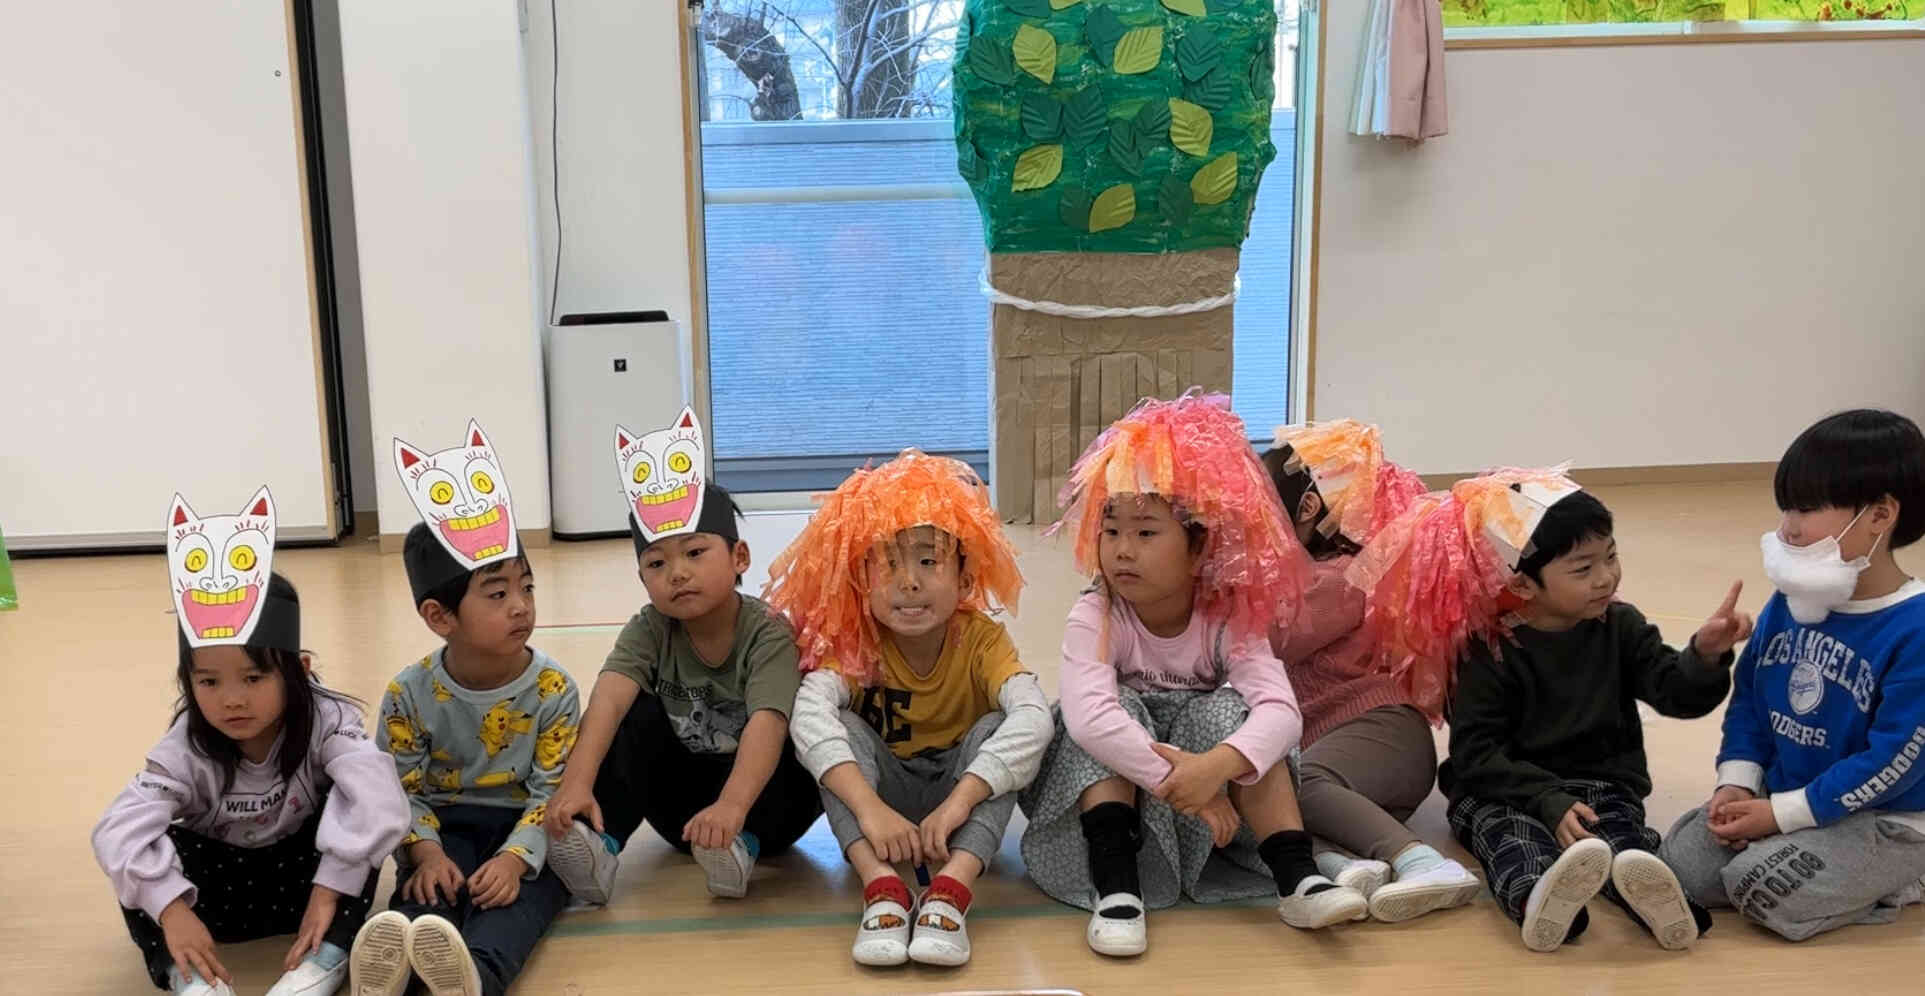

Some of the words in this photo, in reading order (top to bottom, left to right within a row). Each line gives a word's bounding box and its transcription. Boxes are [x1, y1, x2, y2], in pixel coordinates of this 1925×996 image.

[1762, 628, 1793, 666] LOS
[1768, 709, 1827, 747] ODGERS
[1841, 726, 1925, 812] DODGERS
[226, 800, 259, 813] WILL
[1763, 843, 1799, 869] FOREST
[1788, 850, 1827, 880] GO
[1764, 868, 1804, 899] TO
